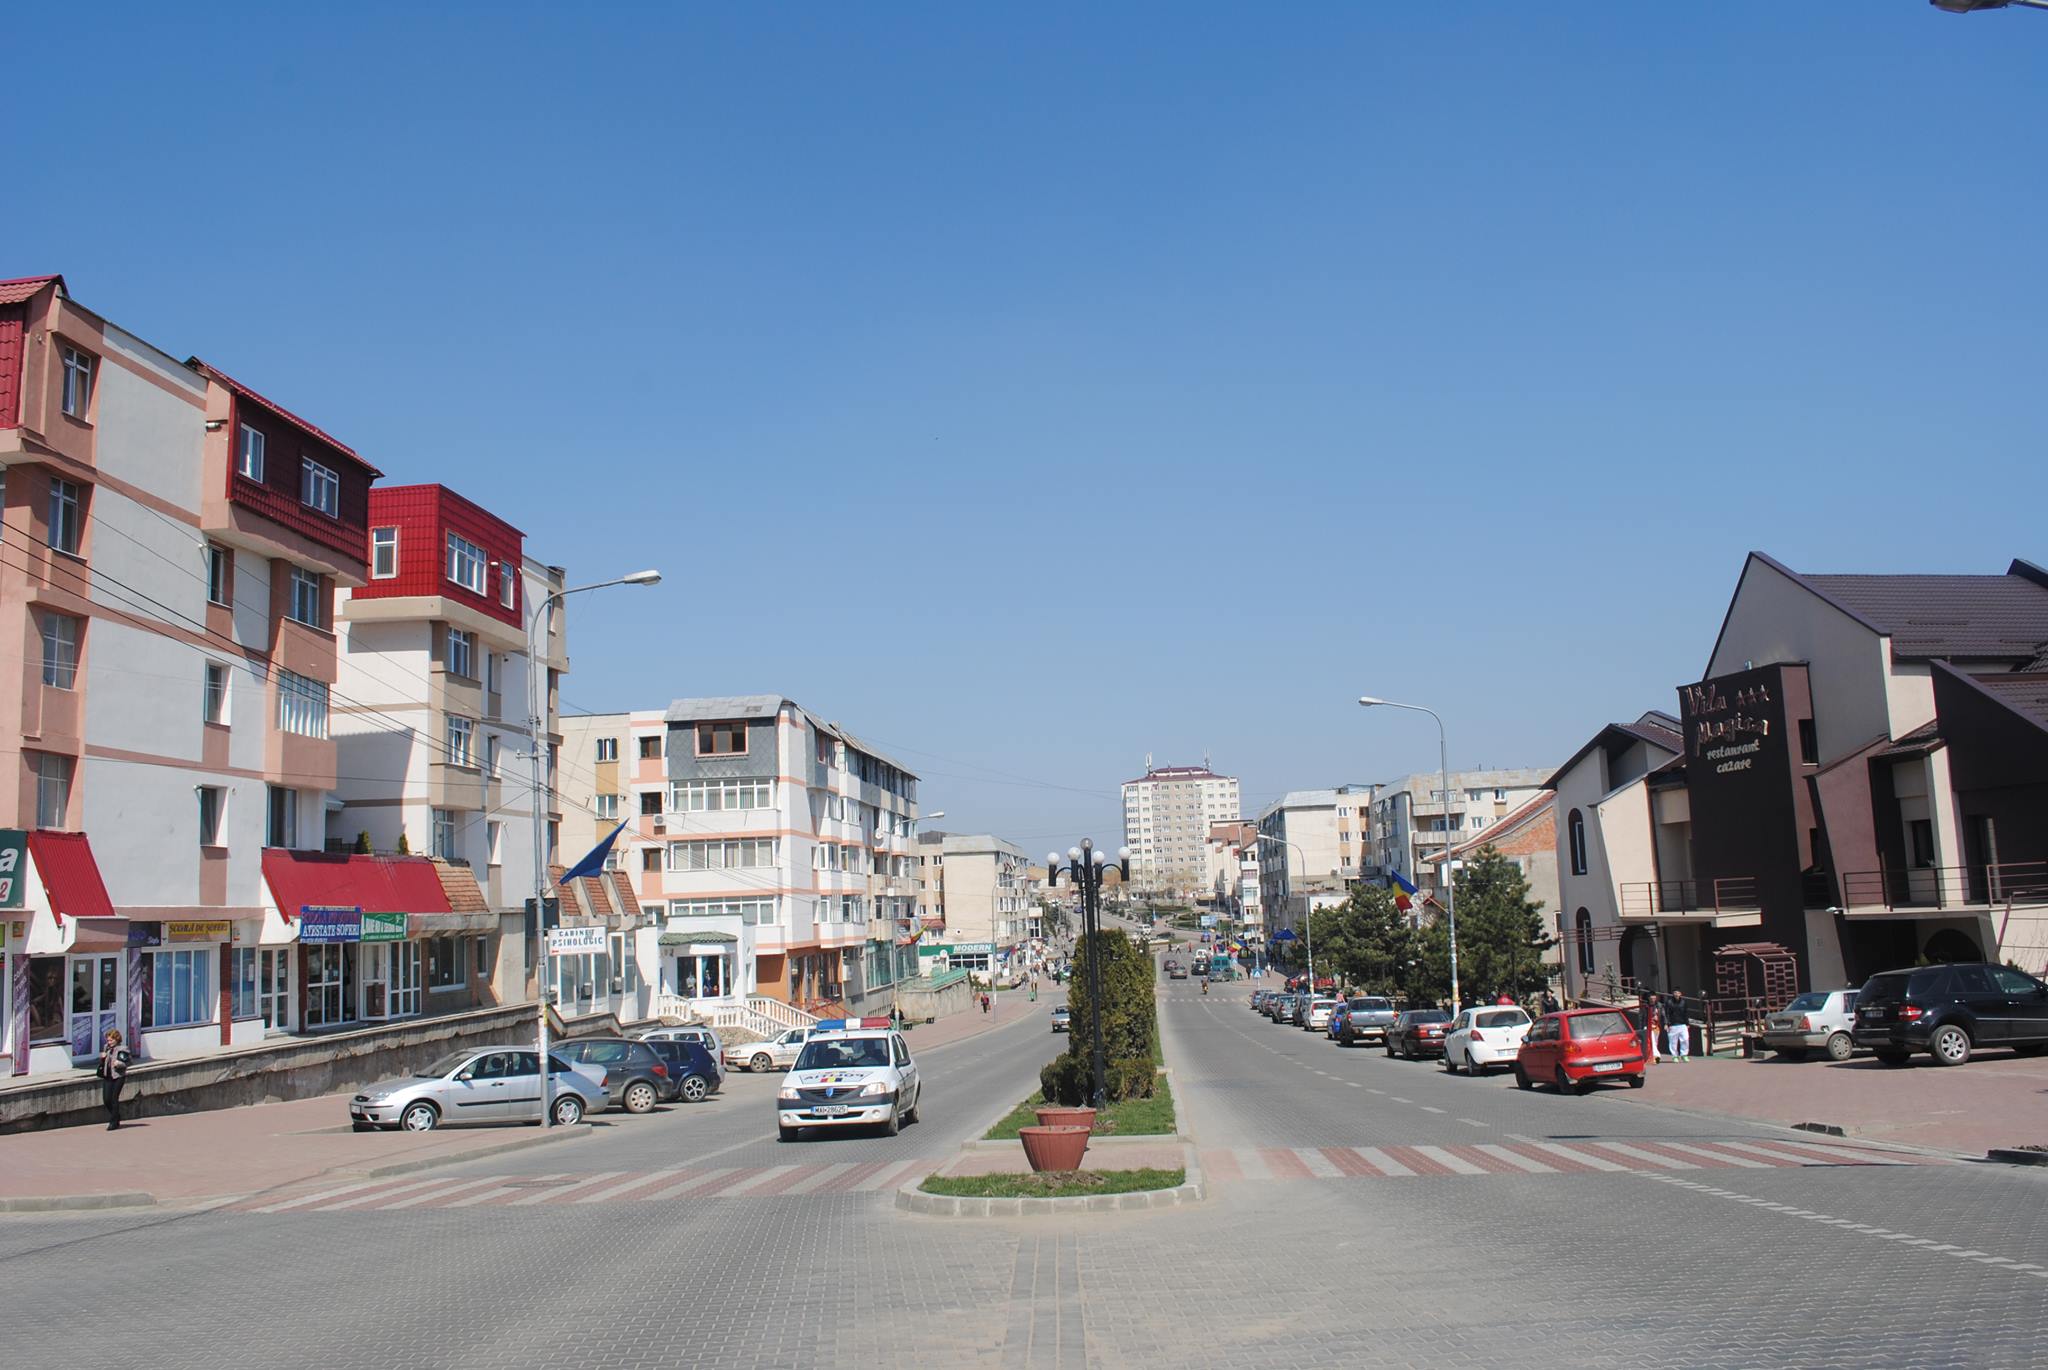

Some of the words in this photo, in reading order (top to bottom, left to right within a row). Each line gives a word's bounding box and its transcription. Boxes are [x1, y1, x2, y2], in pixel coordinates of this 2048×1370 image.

[1706, 738, 1760, 760] restaurant
[1716, 758, 1752, 773] cazare
[302, 924, 335, 937] ATESTATE
[336, 924, 360, 936] SOFERI
[559, 929, 595, 937] CABINET
[552, 937, 603, 947] PSIHOLOGIC
[953, 944, 992, 952] MODERN
